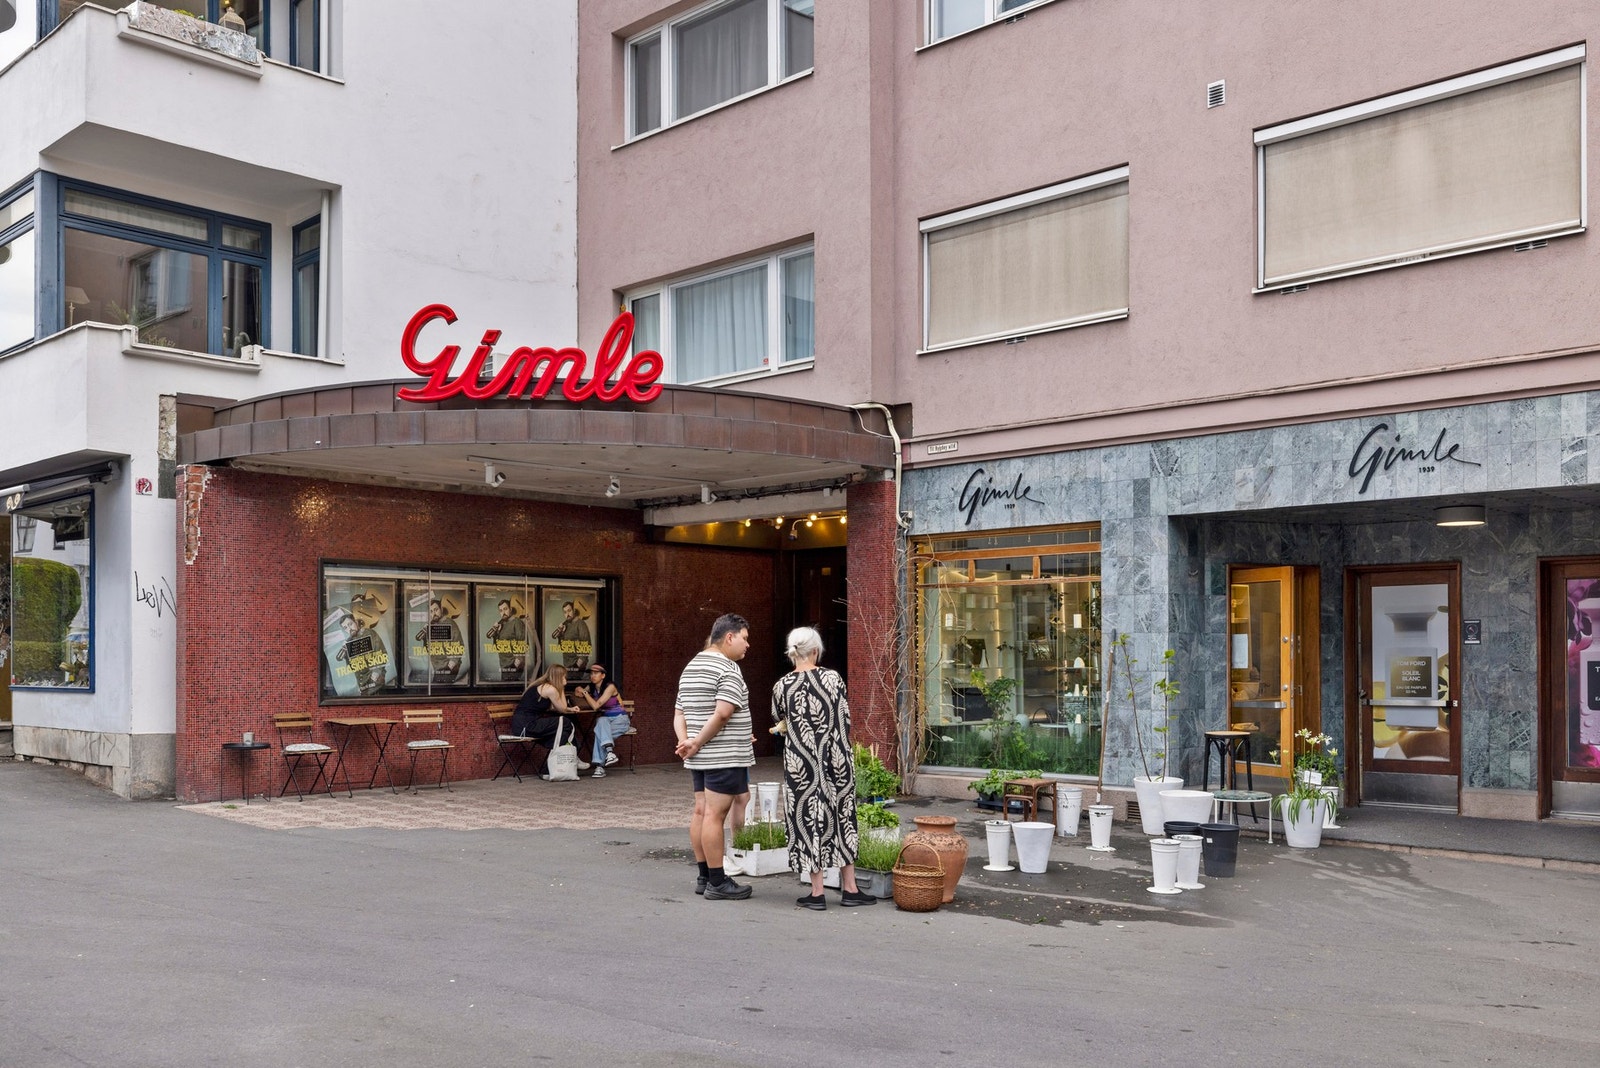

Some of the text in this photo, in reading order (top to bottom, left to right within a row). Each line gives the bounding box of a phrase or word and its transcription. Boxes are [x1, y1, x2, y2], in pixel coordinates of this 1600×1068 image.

[397, 303, 664, 403] Gimle
[1349, 423, 1481, 494] Gimle
[958, 468, 1045, 525] Gimle
[446, 645, 465, 656] SKOR
[484, 643, 512, 653] TRASIGA
[549, 643, 592, 654] TRASIGA SKOR
[336, 661, 368, 677] TRASIGA
[368, 654, 389, 667] SKOR
